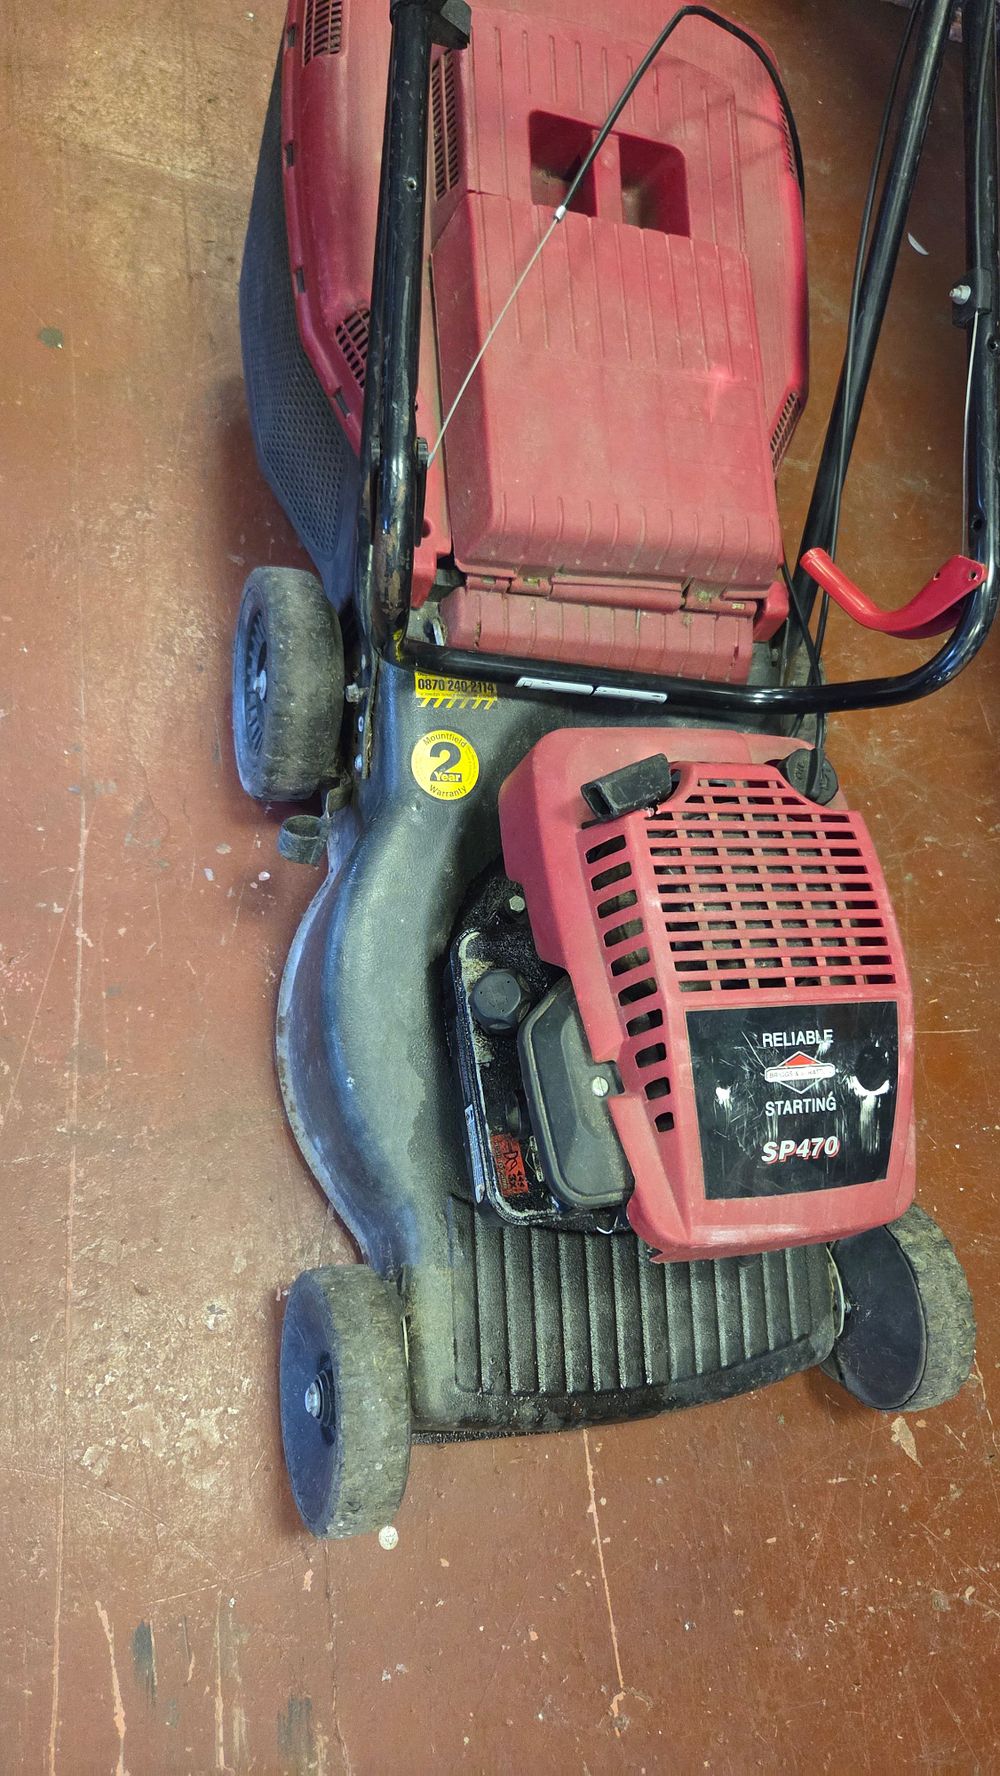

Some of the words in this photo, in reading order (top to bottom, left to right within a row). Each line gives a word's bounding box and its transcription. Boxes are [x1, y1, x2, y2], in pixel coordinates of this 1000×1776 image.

[418, 678, 445, 691] 0870
[447, 680, 468, 692] 240
[470, 680, 494, 693] 2114
[423, 733, 467, 749] Mountfield
[430, 741, 462, 782] 2
[433, 771, 461, 782] Year
[429, 784, 467, 798] Warranty
[762, 1029, 834, 1048] RELIABLE
[765, 1095, 837, 1116] STARTING
[761, 1136, 840, 1164] SP470
